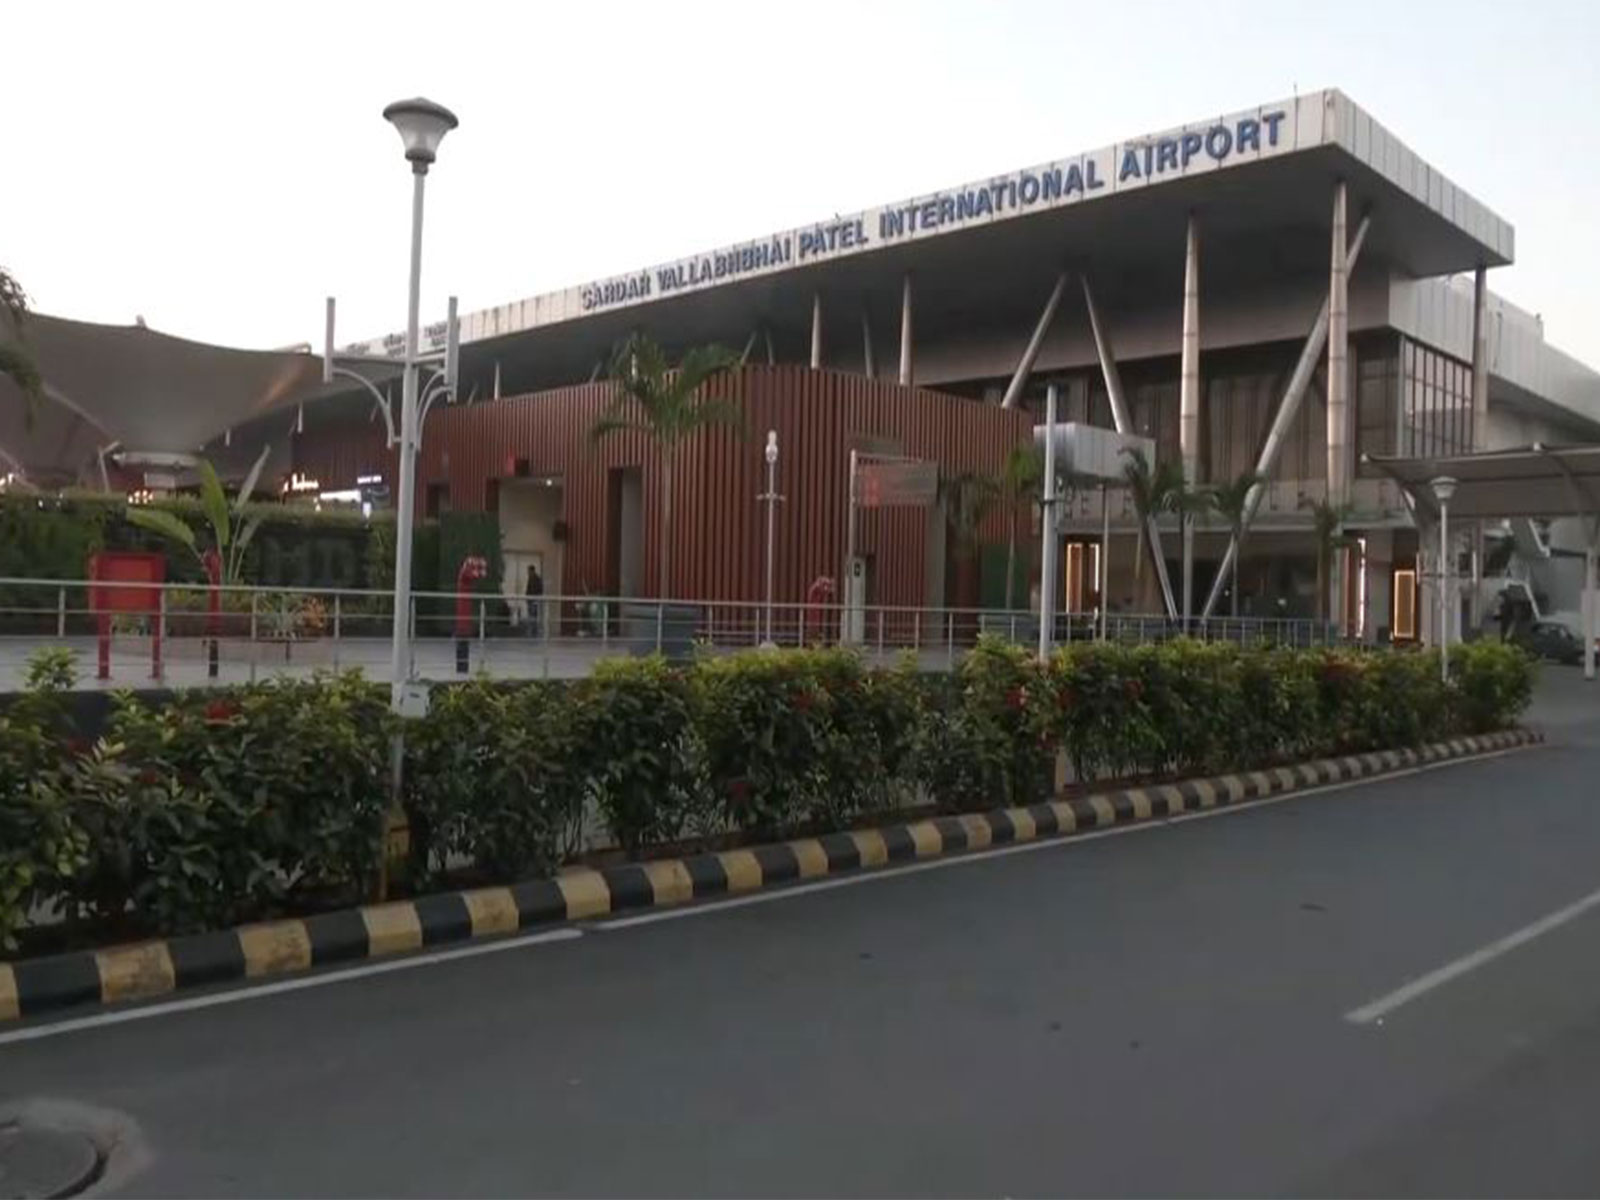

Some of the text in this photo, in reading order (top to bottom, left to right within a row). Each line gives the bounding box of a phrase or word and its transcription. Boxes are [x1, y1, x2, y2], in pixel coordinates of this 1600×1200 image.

[582, 112, 1286, 309] SARDAR VALLABHBHAI PATEL INTERNATIONAL AIRPORT
